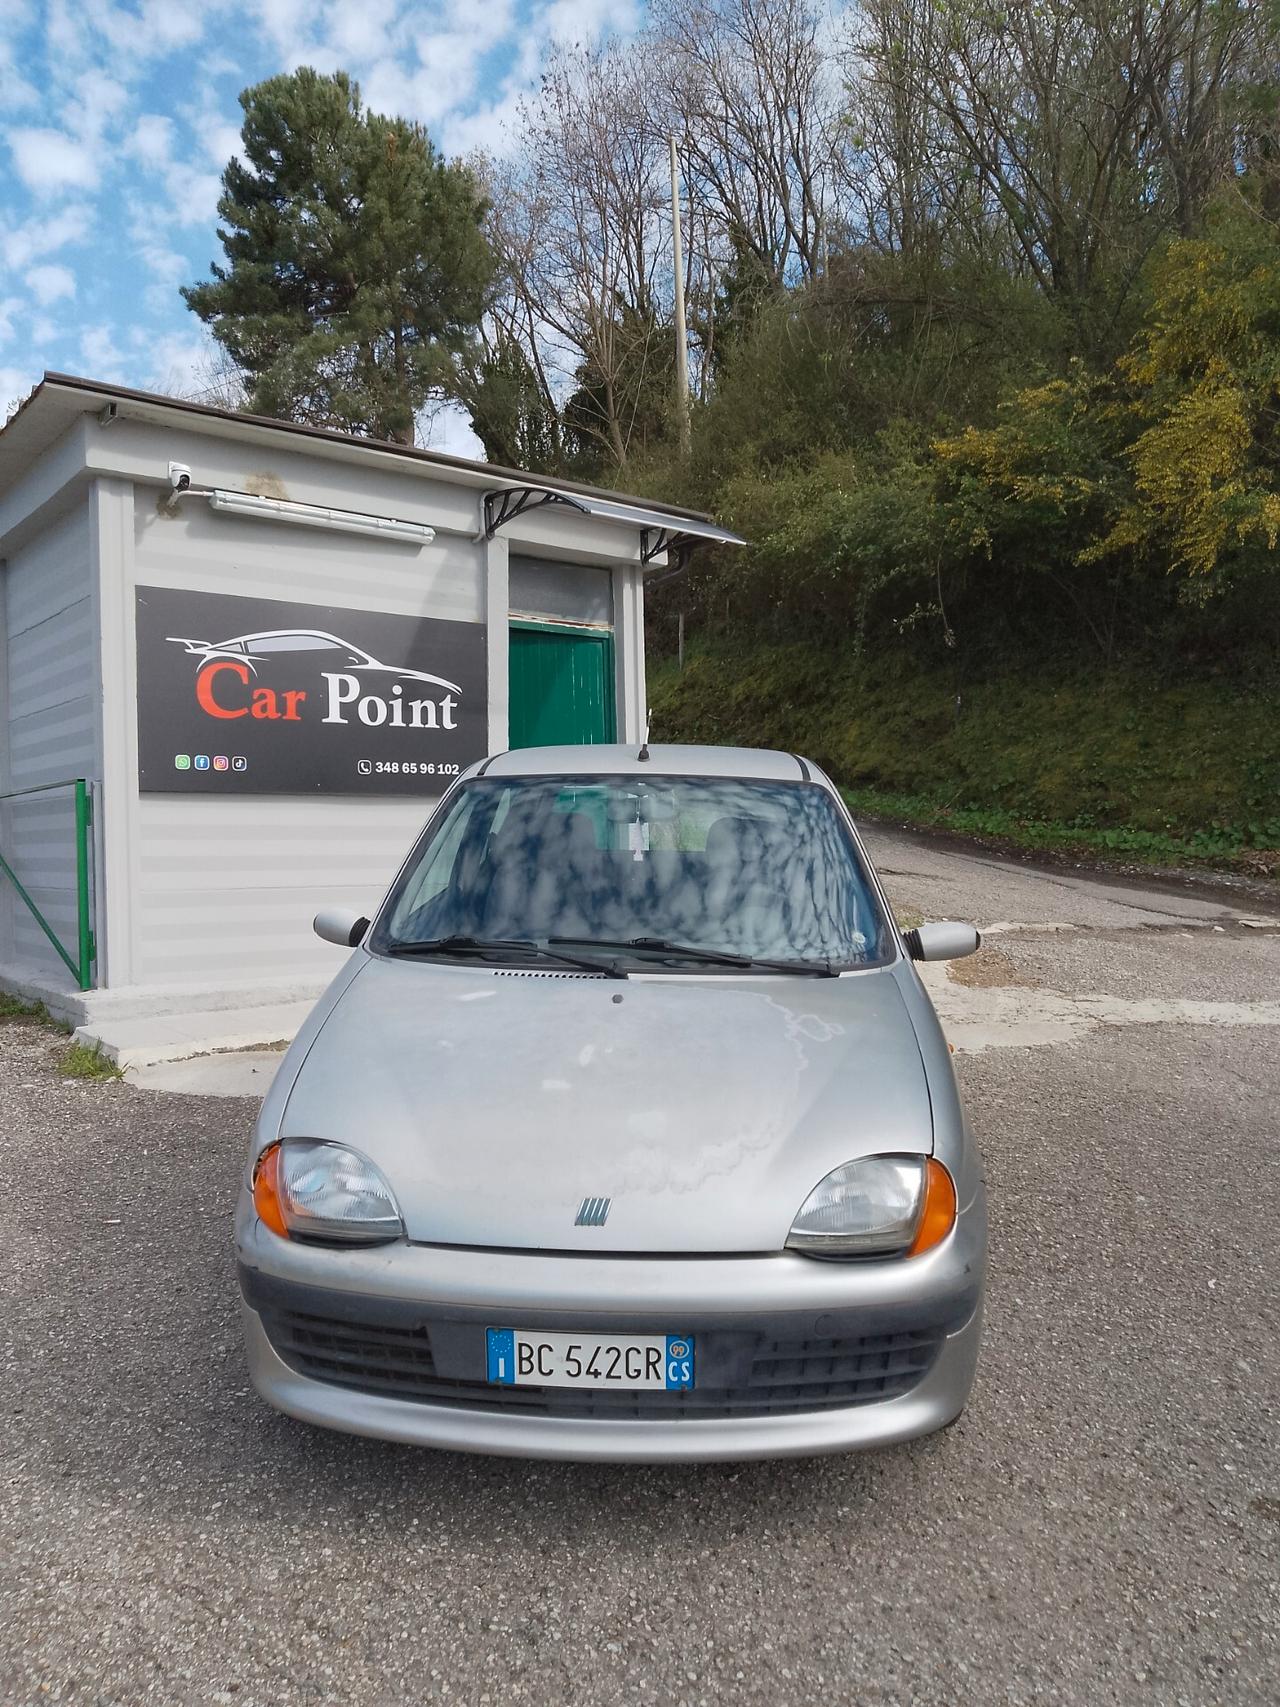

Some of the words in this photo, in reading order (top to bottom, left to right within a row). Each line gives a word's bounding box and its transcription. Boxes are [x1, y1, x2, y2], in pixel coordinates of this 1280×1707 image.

[196, 661, 306, 721] Car
[320, 672, 459, 730] Point
[375, 761, 400, 775] 348
[402, 762, 418, 775] 65
[420, 763, 436, 776] 96
[437, 764, 460, 776] 102
[673, 1345, 685, 1356] 99
[668, 1361, 690, 1382] CS
